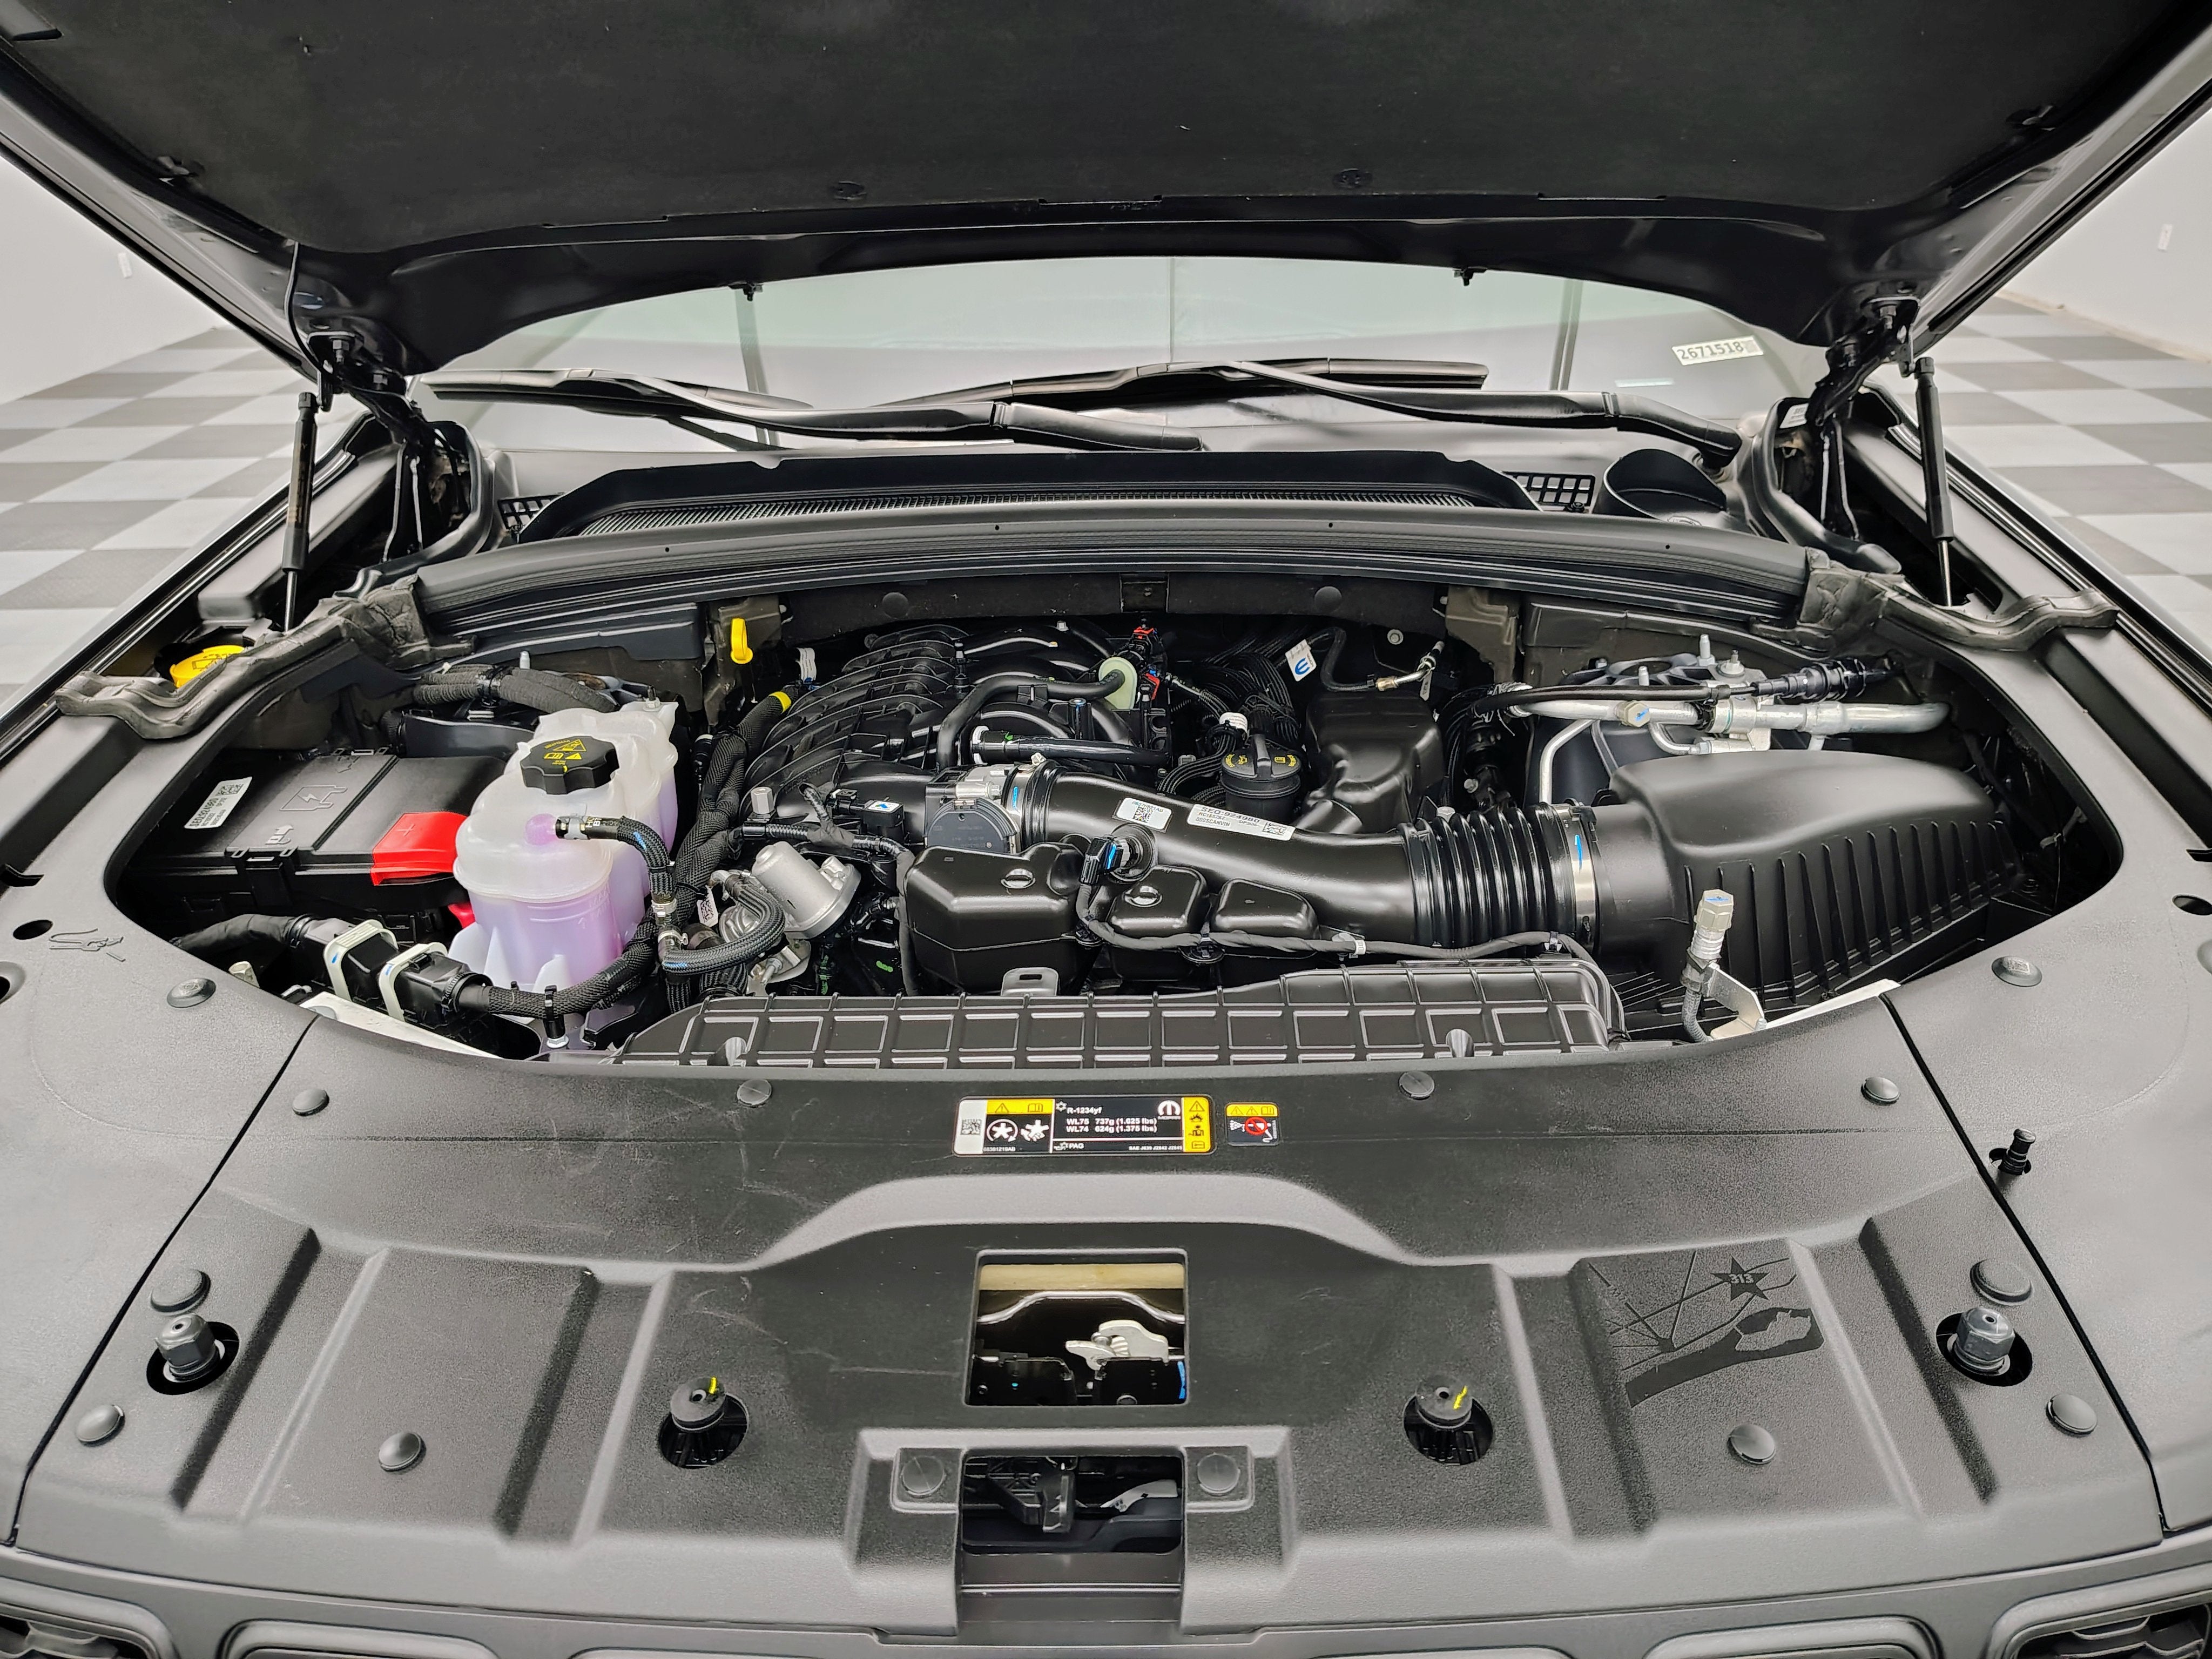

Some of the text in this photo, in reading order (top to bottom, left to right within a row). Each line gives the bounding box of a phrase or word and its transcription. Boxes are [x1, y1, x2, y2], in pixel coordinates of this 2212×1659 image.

[1677, 341, 1744, 360] 2671518
[1067, 1107, 1103, 1115] R-1234yf
[1095, 1118, 1115, 1126] 737g
[1142, 1117, 1157, 1126] lbs)
[1116, 1125, 1140, 1133] (1.375
[1142, 1125, 1157, 1133] lbs)
[1729, 1273, 1754, 1284] 313
